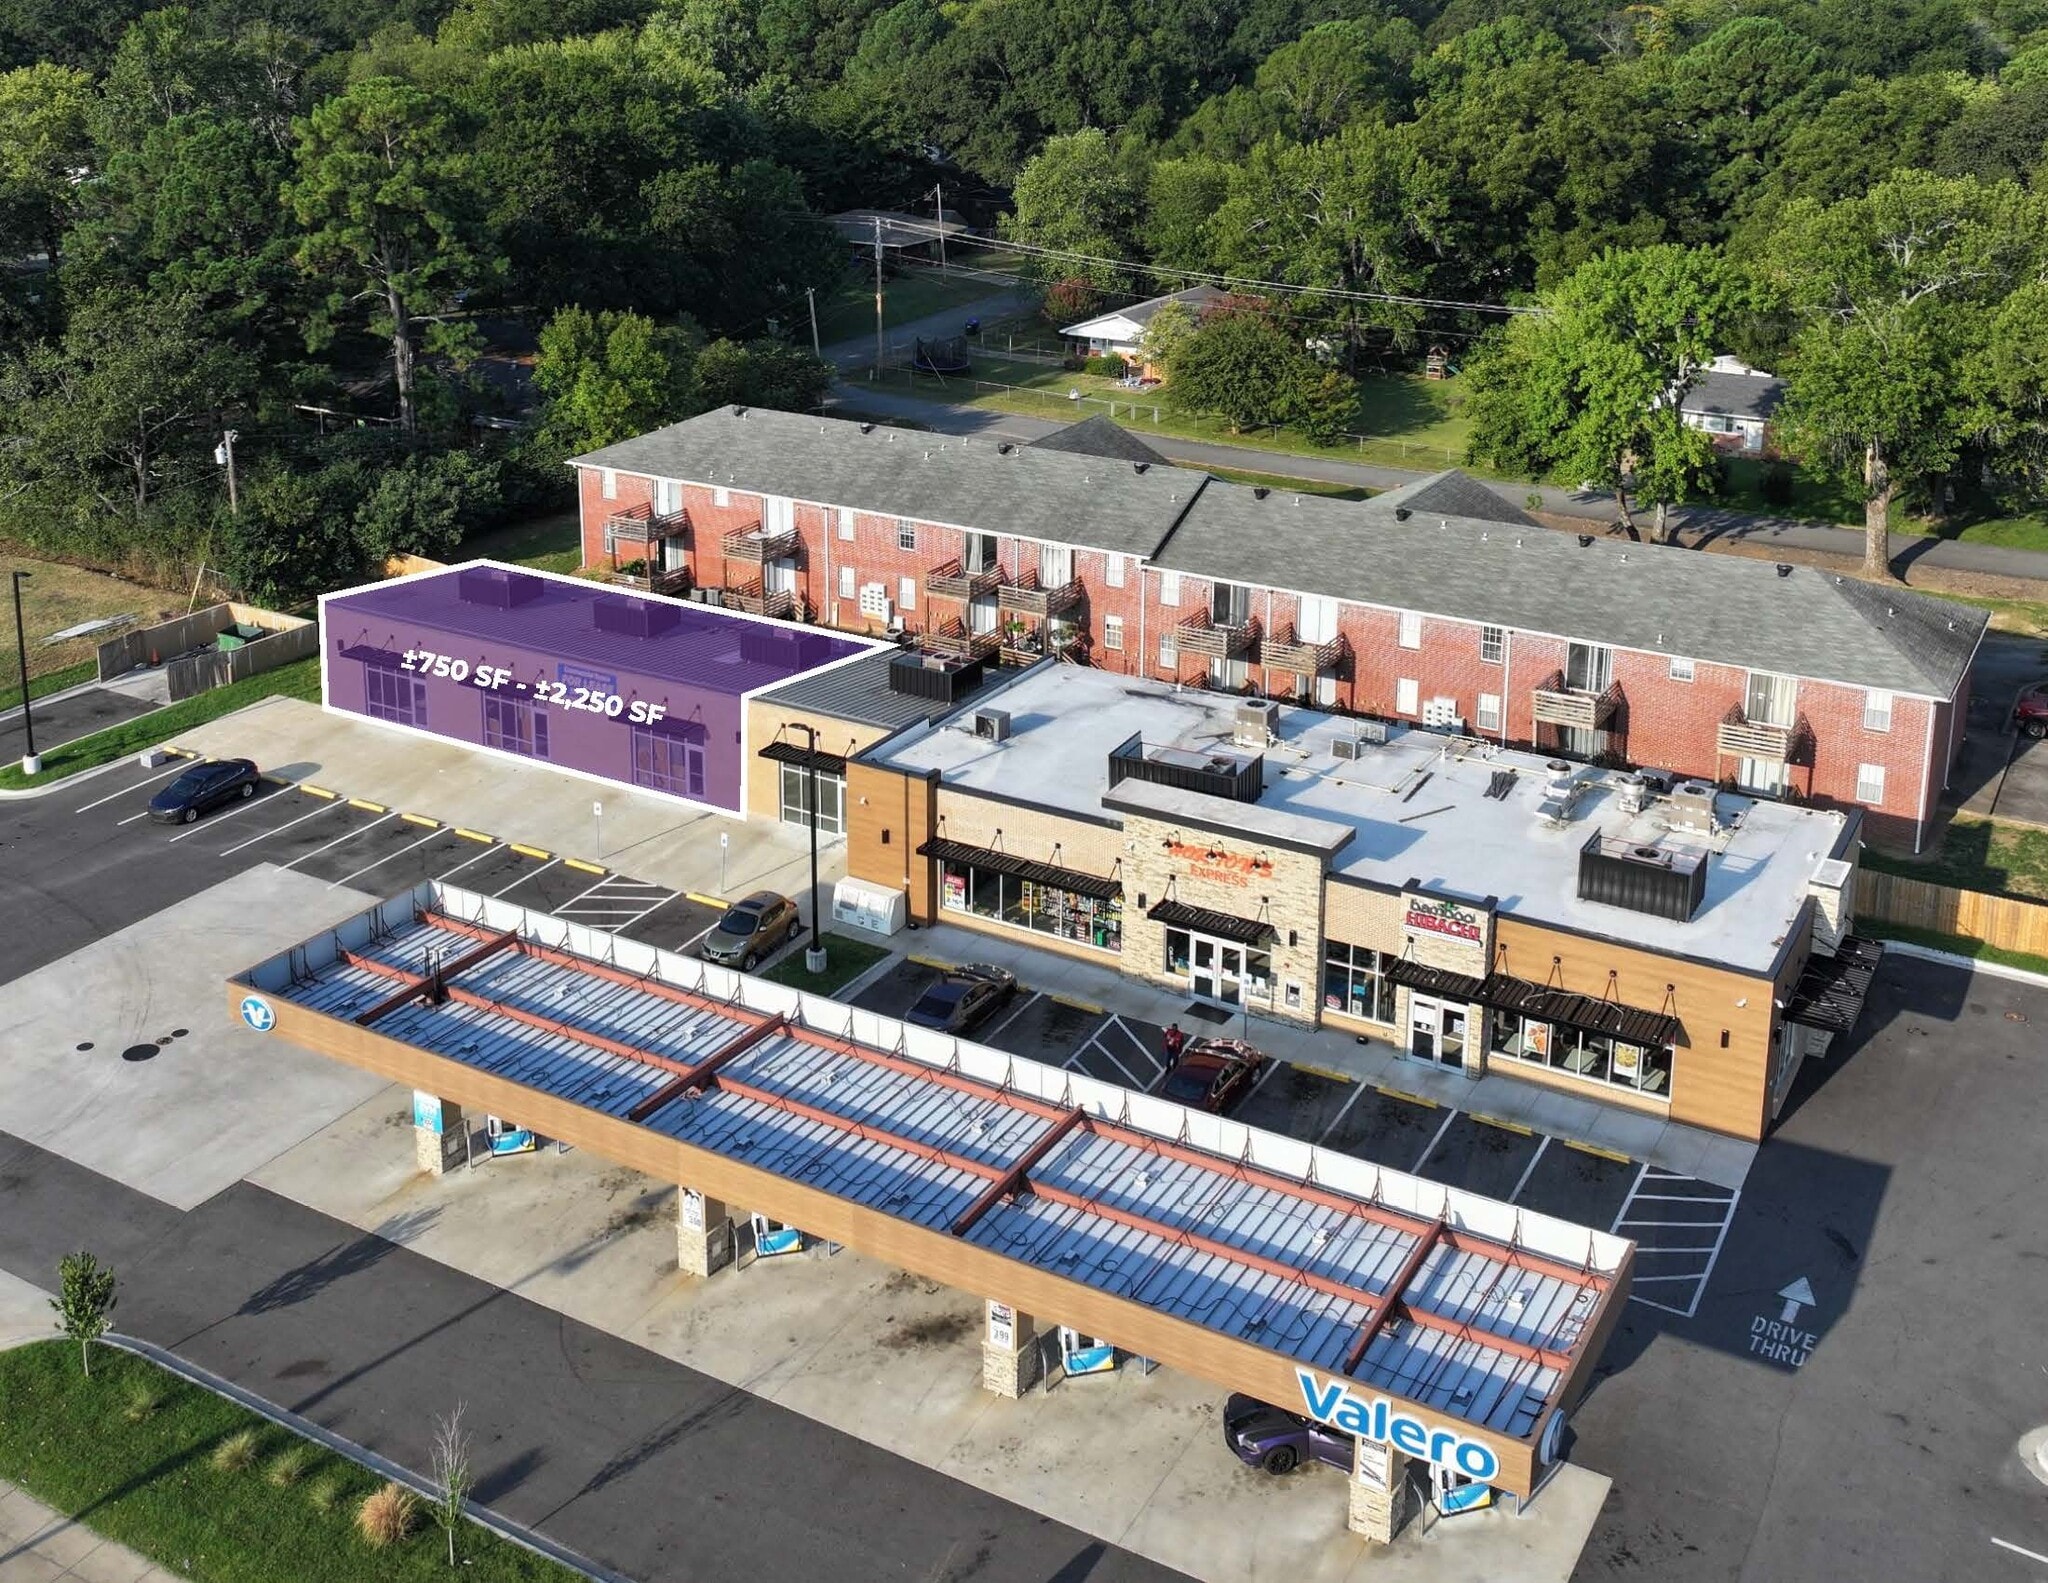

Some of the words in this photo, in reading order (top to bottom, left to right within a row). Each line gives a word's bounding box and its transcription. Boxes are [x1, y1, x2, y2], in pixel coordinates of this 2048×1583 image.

[1190, 863, 1248, 888] EXPRESS
[1406, 911, 1481, 941] HIBACHI
[1751, 1315, 1817, 1351] DRIVE
[1750, 1334, 1806, 1367] THRU
[1298, 1371, 1496, 1479] Valero
